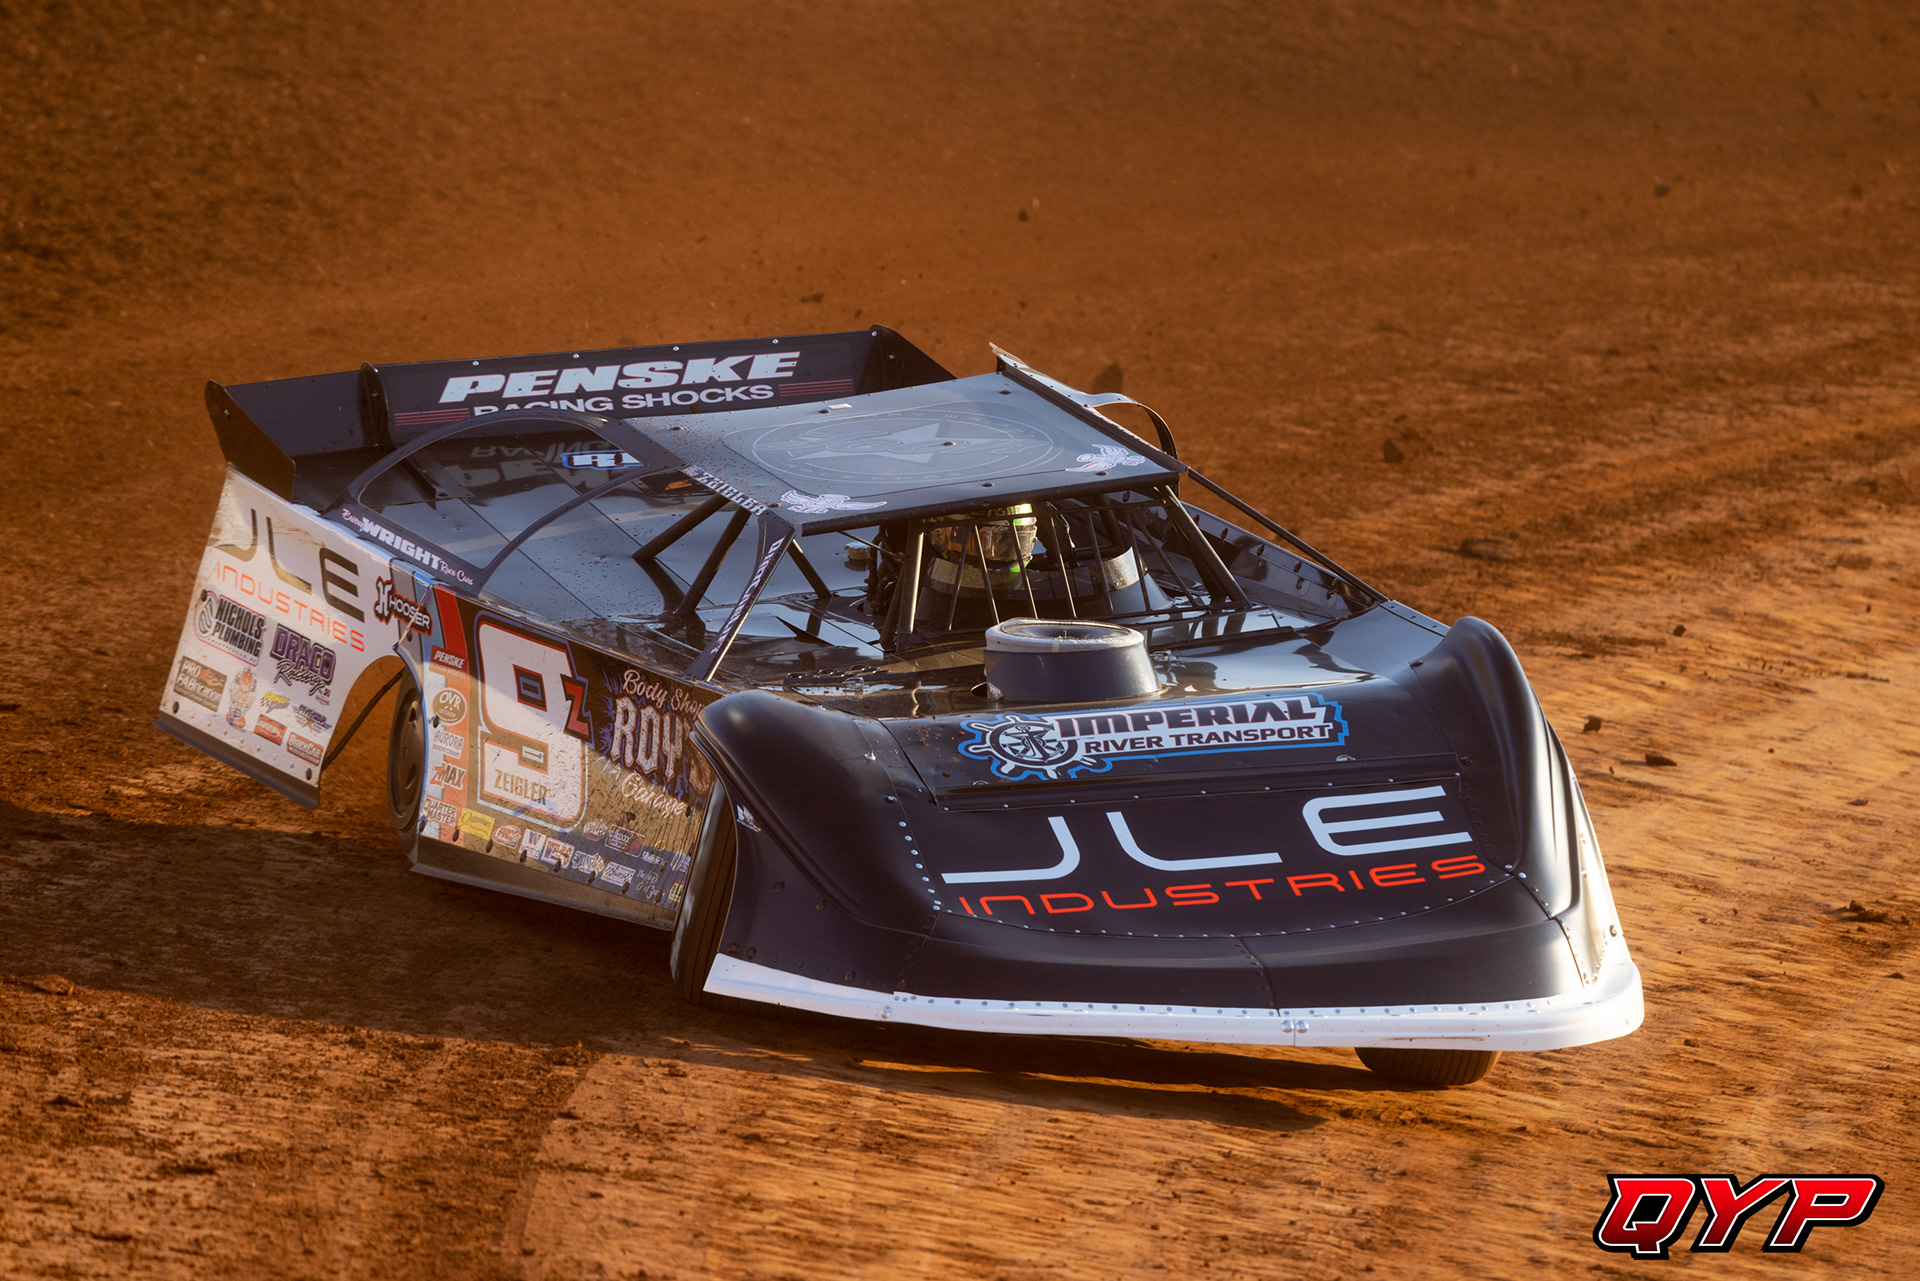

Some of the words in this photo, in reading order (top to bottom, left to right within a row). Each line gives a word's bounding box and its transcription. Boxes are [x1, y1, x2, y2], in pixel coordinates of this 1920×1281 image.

[438, 351, 801, 404] PENSKE
[622, 384, 774, 410] SHOCKS
[214, 508, 366, 623] JLE
[361, 517, 442, 570] WRIGHT
[440, 560, 457, 577] Race
[456, 570, 475, 586] Cars
[215, 598, 265, 640] NICHOLS
[216, 562, 366, 652] INDUSTRIES
[388, 594, 431, 629] HOOSER
[212, 621, 262, 657] PLUMBING
[272, 625, 335, 684] DRACO
[181, 660, 202, 675] PRO
[274, 659, 326, 696] Racing
[433, 650, 466, 669] PENSKE
[439, 691, 461, 711] OVR
[622, 669, 668, 708] Body
[1054, 699, 1317, 738] IMPERIAL
[433, 730, 464, 751] AURORA
[1084, 735, 1164, 754] RIVER
[1169, 724, 1331, 746] TRANSPORT
[494, 769, 548, 806] ZEIGLER
[621, 770, 687, 820] Garage
[424, 798, 457, 816] QUARTER
[427, 809, 456, 827] MASTER
[941, 785, 1473, 884] JLE
[958, 854, 1487, 916] INDUSTRIES
